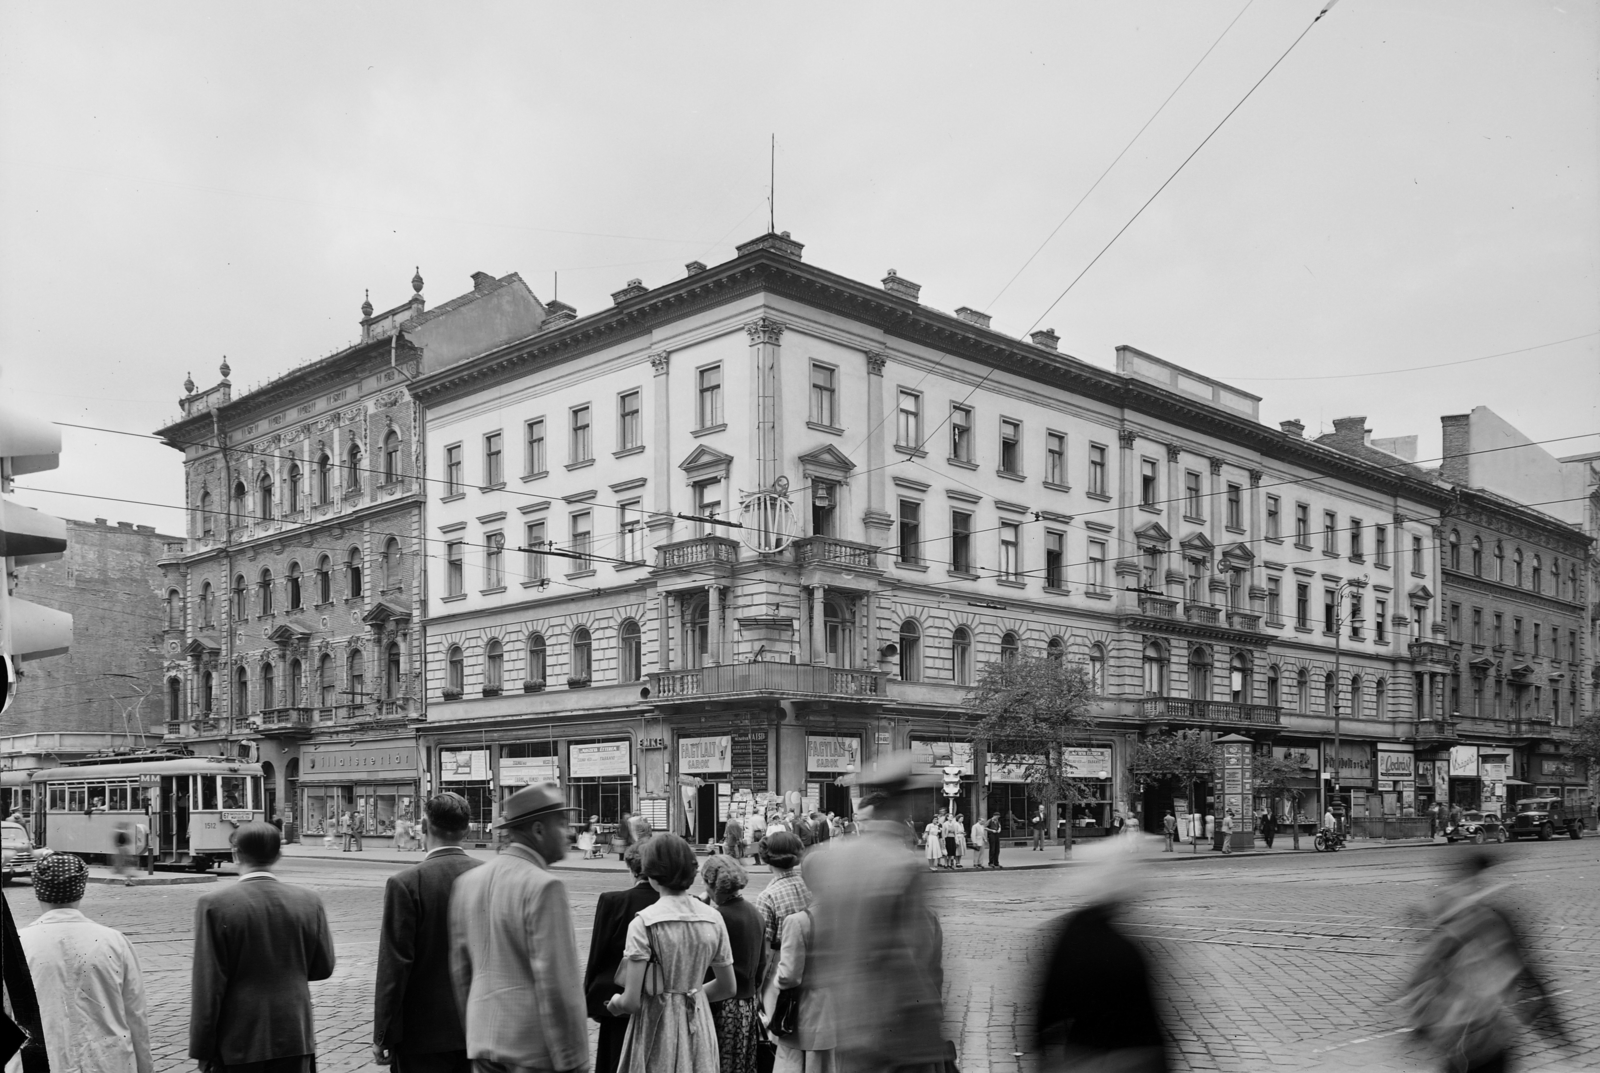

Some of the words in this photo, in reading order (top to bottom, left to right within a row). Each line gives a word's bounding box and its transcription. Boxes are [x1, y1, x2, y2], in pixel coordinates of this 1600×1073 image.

[681, 741, 716, 759] FAGYLALT
[808, 741, 845, 757] FAGYLALT
[688, 759, 710, 769] SAROK
[816, 758, 839, 768] SAROK
[140, 774, 160, 782] MM
[686, 799, 693, 809] 1
[223, 812, 230, 820] 67
[204, 822, 217, 830] 1512
